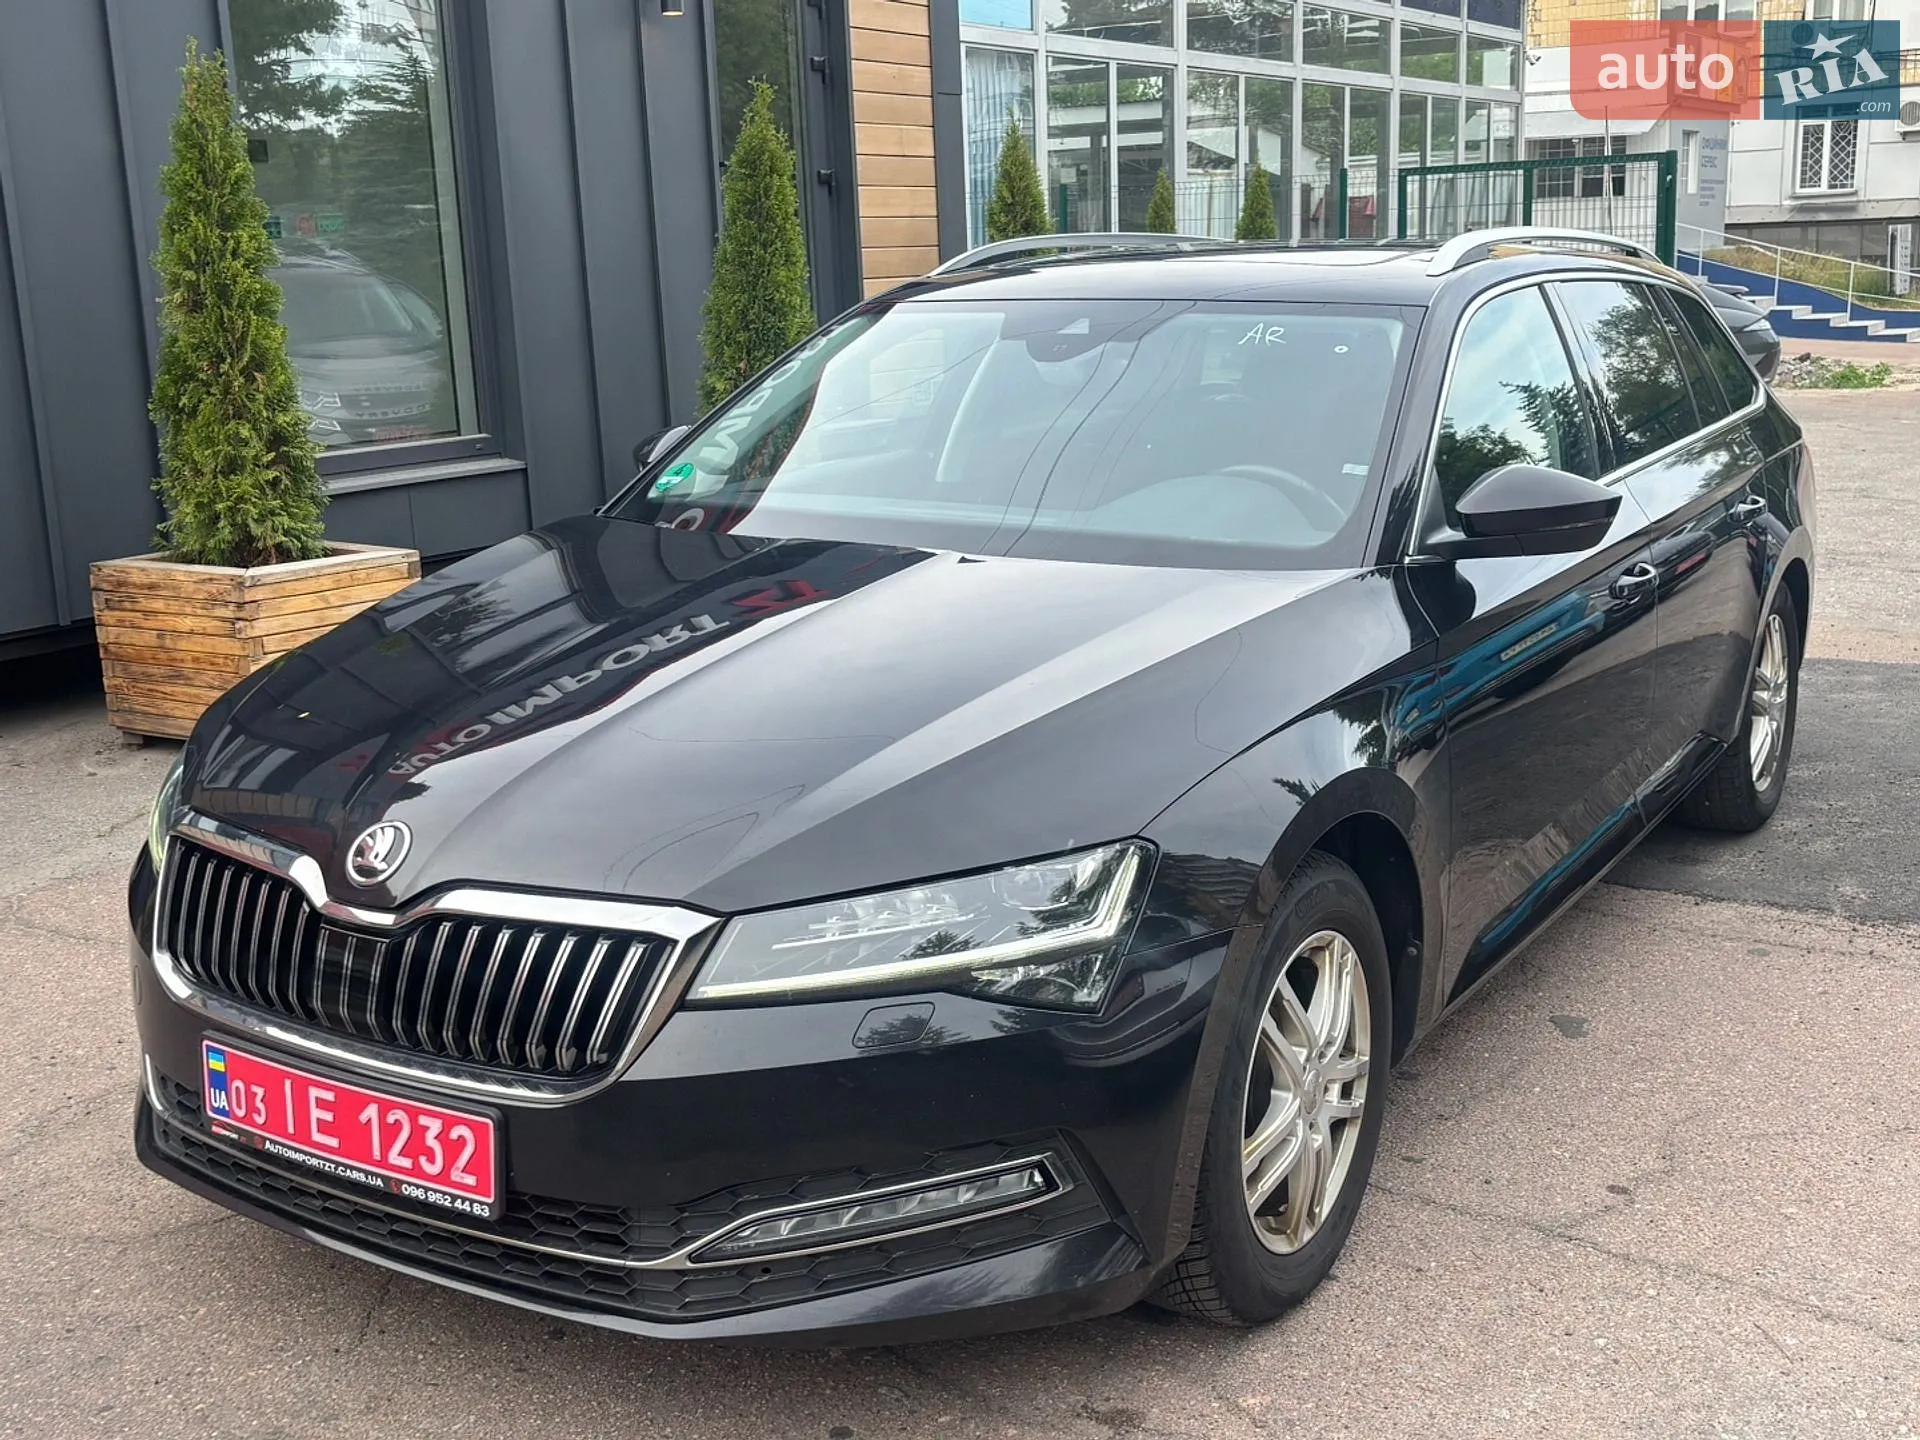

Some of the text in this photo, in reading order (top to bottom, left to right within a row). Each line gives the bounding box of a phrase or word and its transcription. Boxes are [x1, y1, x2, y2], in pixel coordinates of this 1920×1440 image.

[1238, 322, 1287, 347] AR
[210, 1087, 229, 1111] UA
[231, 1079, 268, 1126] 03
[358, 1102, 478, 1187] 1232
[401, 1183, 426, 1200] 096
[427, 1191, 452, 1207] 952
[454, 1198, 471, 1213] 44
